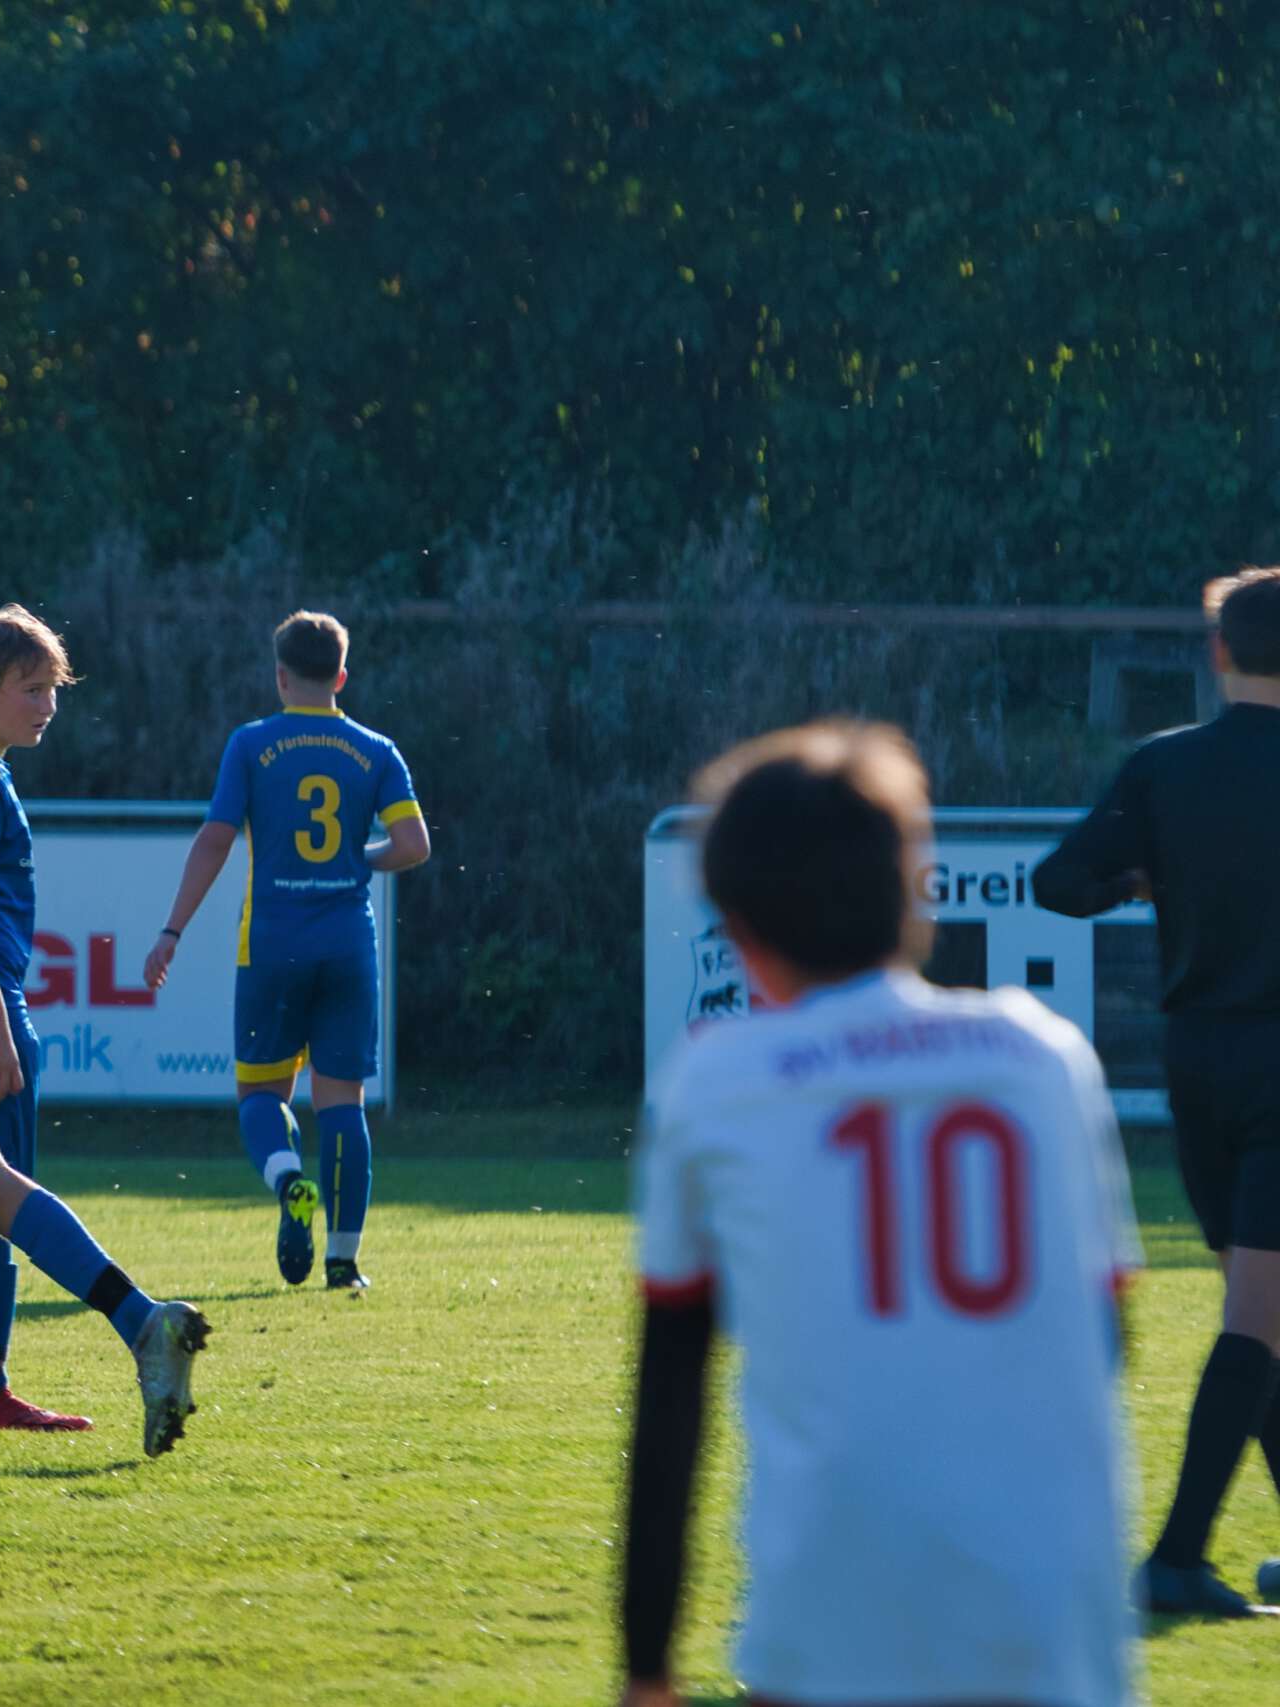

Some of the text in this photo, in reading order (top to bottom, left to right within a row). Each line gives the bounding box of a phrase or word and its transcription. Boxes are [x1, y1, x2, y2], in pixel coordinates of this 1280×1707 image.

[259, 734, 372, 773] SC Fürstenfeldbruck
[295, 774, 342, 863] 3
[916, 861, 1027, 908] Grei
[39, 1022, 113, 1073] nik
[828, 1098, 1032, 1318] 10
